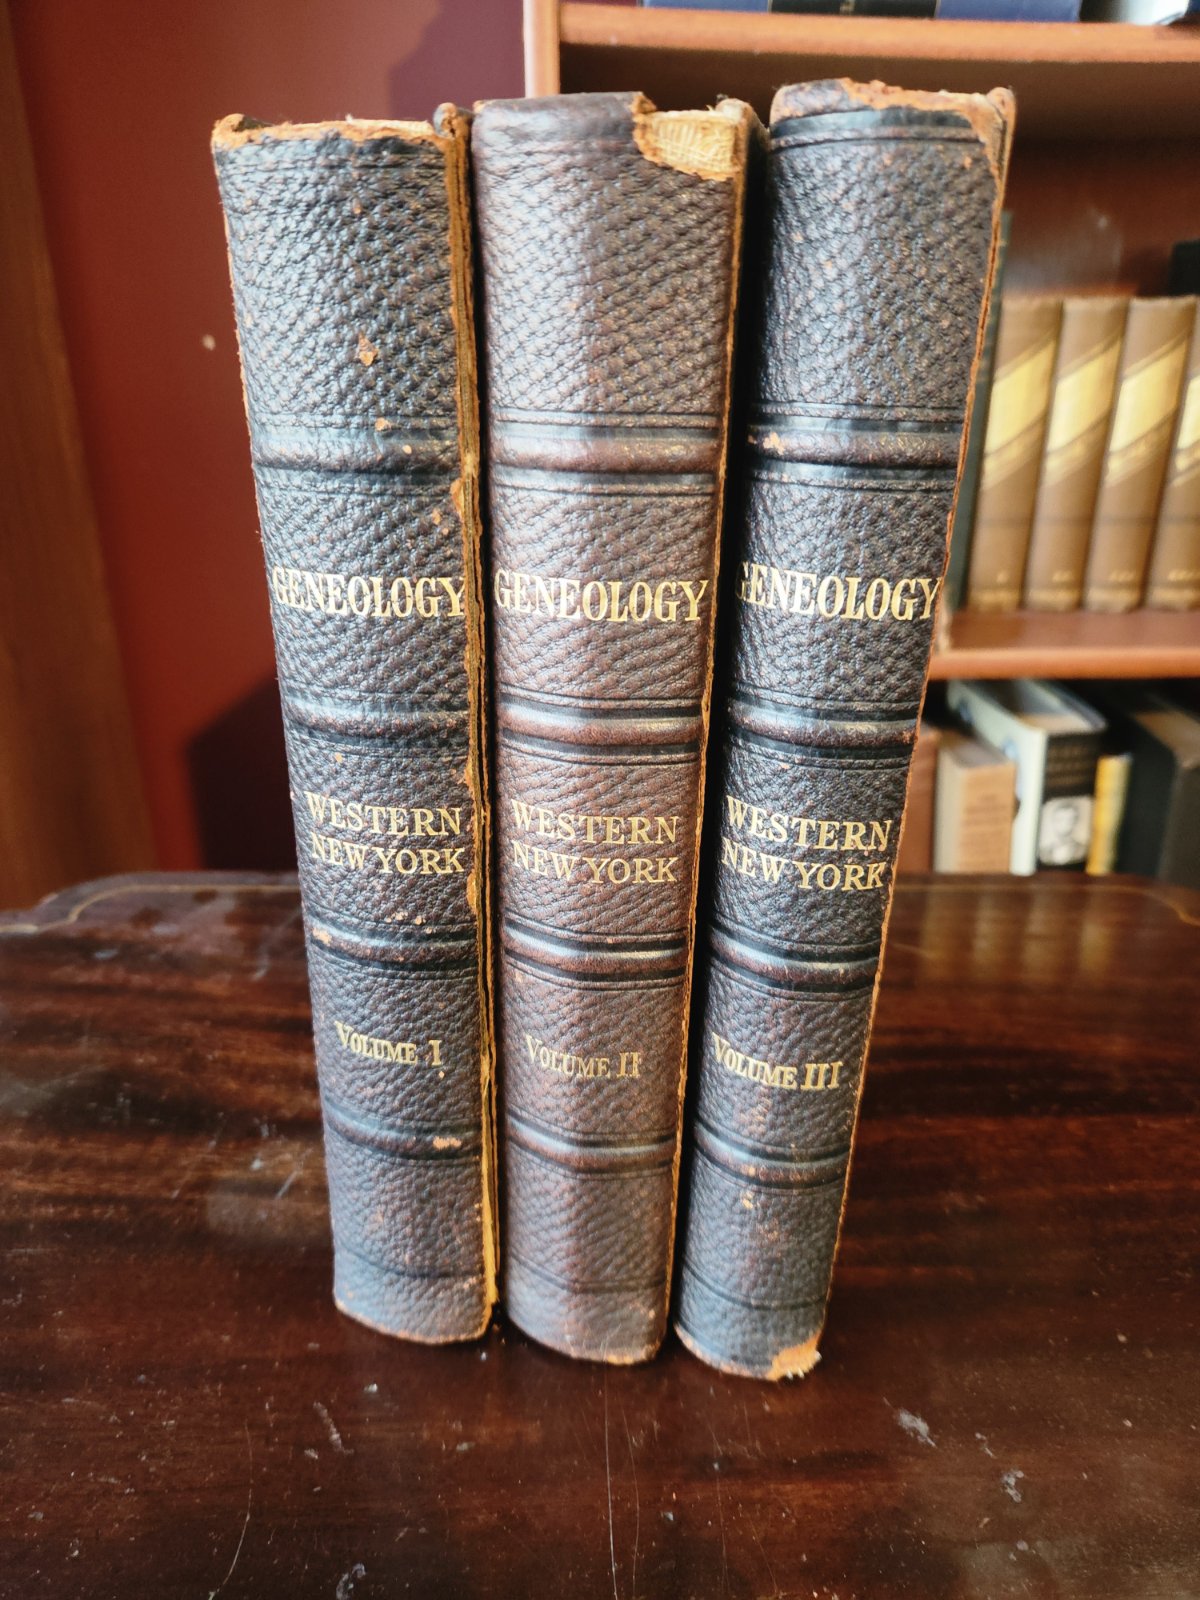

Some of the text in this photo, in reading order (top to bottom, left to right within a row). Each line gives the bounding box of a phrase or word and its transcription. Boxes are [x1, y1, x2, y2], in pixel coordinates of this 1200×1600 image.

[272, 566, 466, 618] GENEOLOGY
[494, 569, 709, 622] GENEOLOGY
[738, 561, 943, 621] GENEOLOGY
[304, 791, 461, 836] WESTERN
[511, 798, 679, 845] WESTERN
[726, 795, 893, 851] WESTERN
[310, 831, 465, 874] NEW YORK
[511, 840, 679, 884] NEW YORK
[721, 836, 887, 891] NEW YORK
[428, 1039, 443, 1066] I
[616, 1051, 642, 1079] II
[800, 1061, 844, 1091] III
